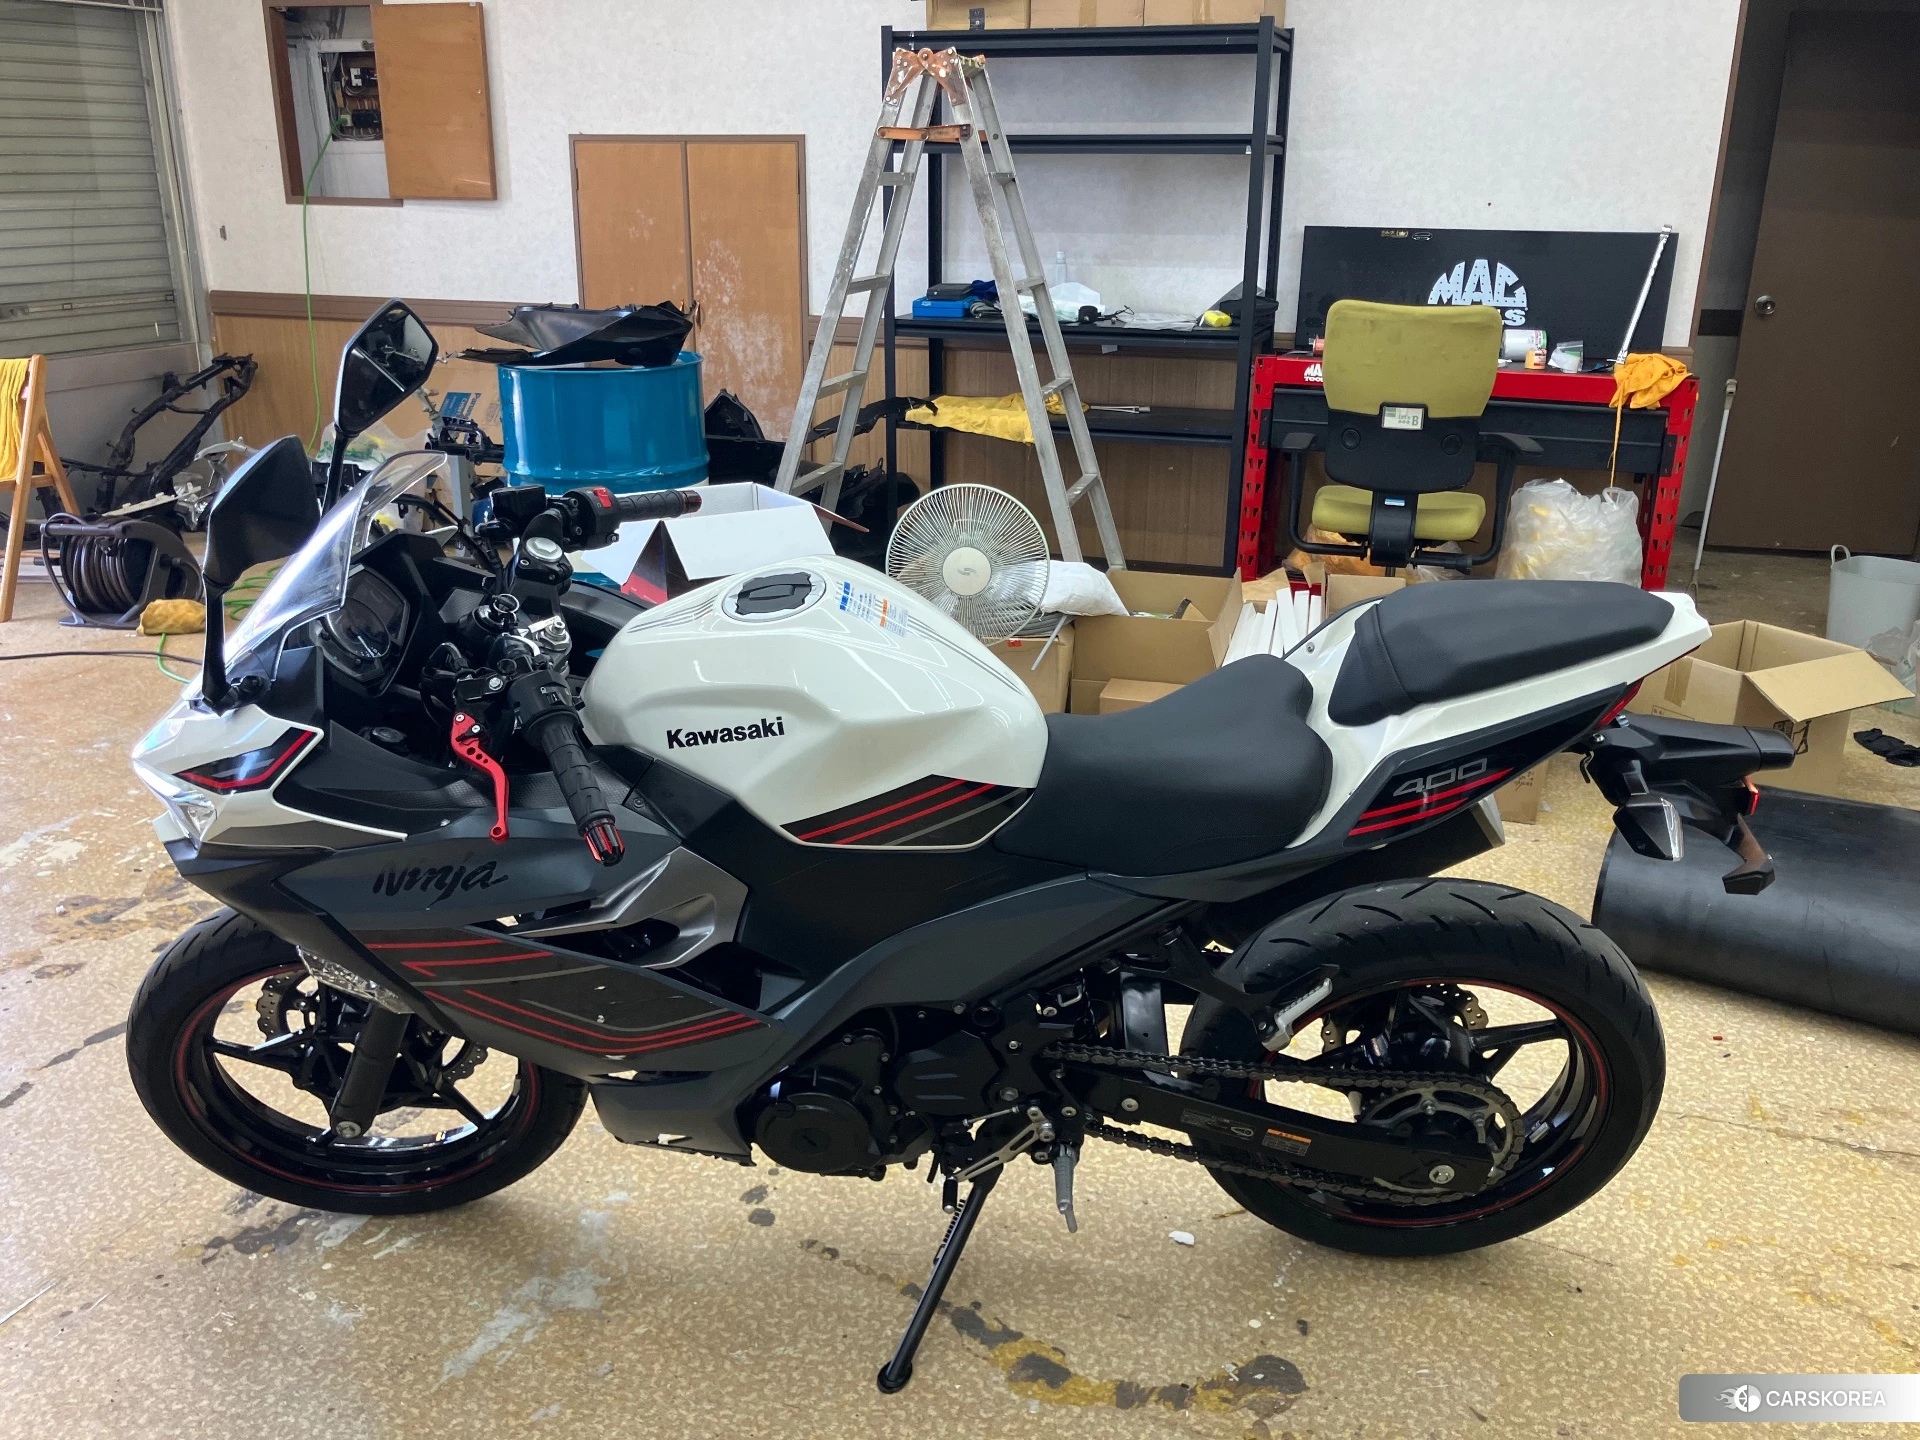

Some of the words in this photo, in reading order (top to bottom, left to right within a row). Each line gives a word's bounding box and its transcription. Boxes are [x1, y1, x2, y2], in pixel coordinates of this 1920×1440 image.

[1427, 259, 1527, 307] MAC
[1304, 363, 1323, 376] MA
[666, 716, 785, 749] Kawasaki
[1393, 758, 1487, 796] 400
[372, 853, 509, 908] Ninja
